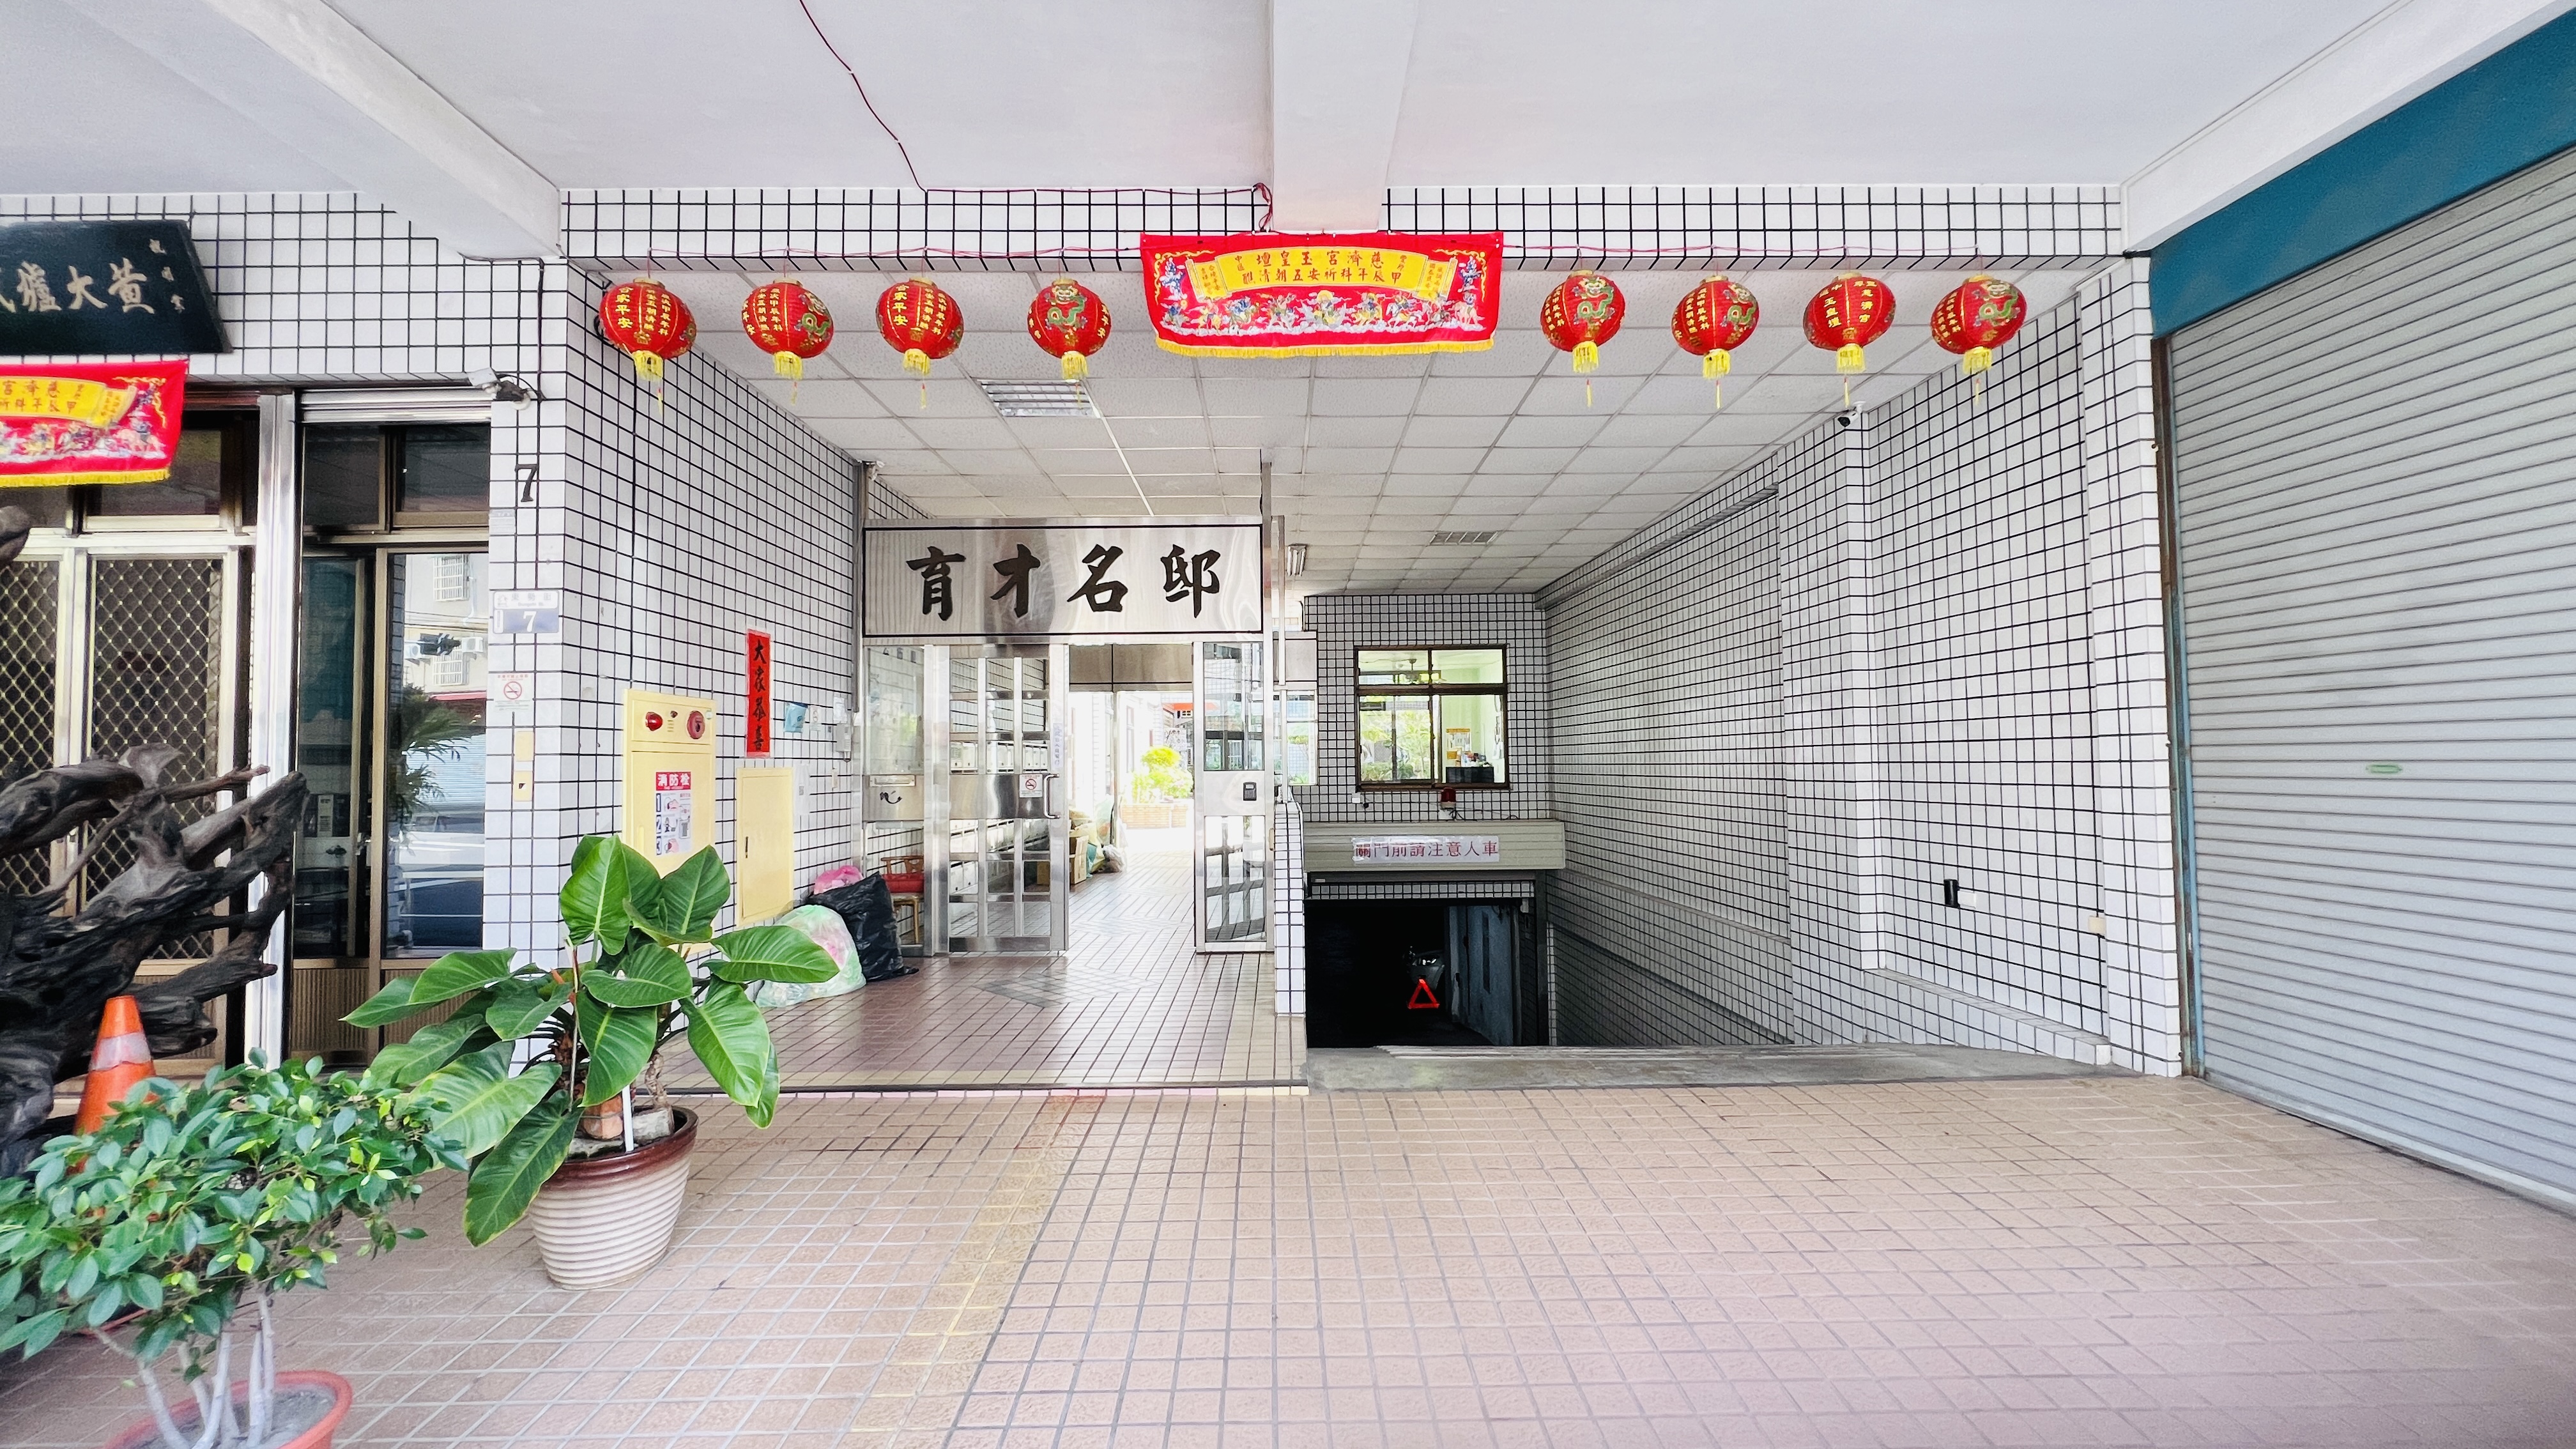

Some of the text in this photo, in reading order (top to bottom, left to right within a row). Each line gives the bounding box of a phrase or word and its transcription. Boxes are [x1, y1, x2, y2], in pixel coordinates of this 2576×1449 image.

[892, 284, 910, 326] 合家平安
[514, 464, 539, 502] 7
[906, 544, 1221, 622] 育才名邸
[523, 611, 537, 632] 7
[657, 773, 690, 786] 消防栓
[1356, 840, 1499, 858] 關門前請注意人車
